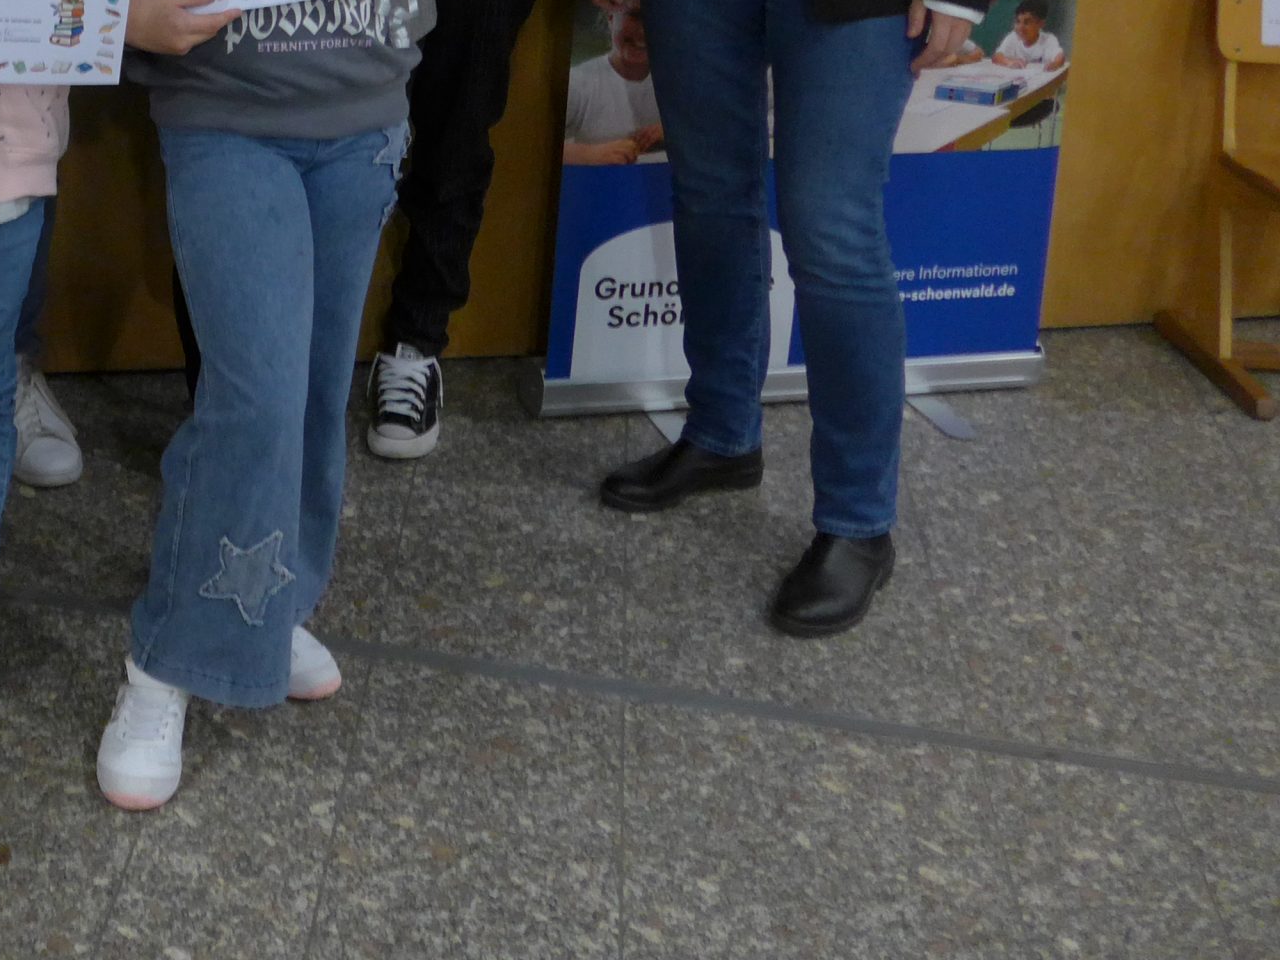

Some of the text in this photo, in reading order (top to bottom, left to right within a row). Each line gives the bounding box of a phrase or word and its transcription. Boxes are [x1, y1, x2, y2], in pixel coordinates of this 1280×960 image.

[257, 38, 372, 54] ETERNITY FOREVER
[918, 262, 1018, 280] Informationen
